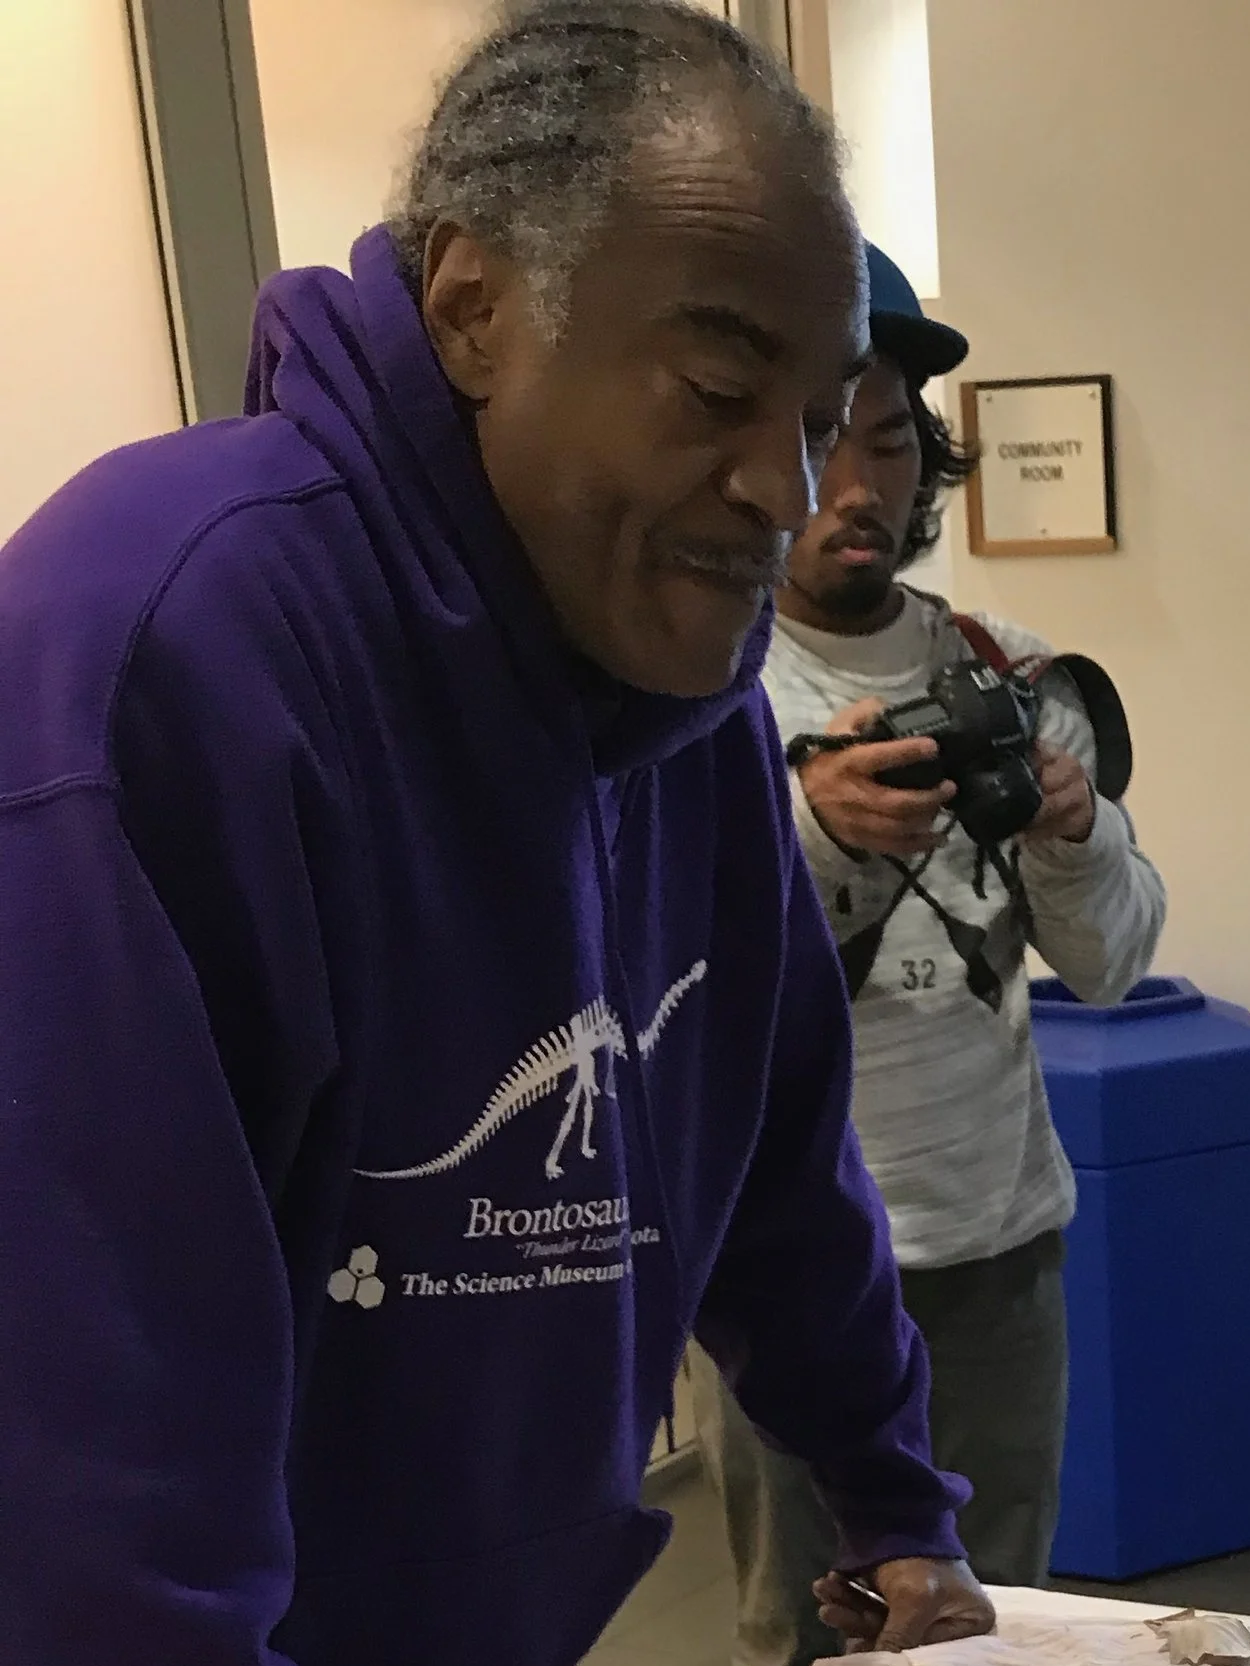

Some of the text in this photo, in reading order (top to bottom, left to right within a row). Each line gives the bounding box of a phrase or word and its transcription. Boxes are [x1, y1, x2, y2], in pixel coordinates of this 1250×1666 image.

[998, 440, 1084, 460] COMMUNITY
[1020, 466, 1064, 482] ROOM
[901, 958, 937, 991] 32
[400, 1272, 448, 1297] The
[451, 1271, 537, 1297] Science
[539, 1263, 624, 1288] Museum
